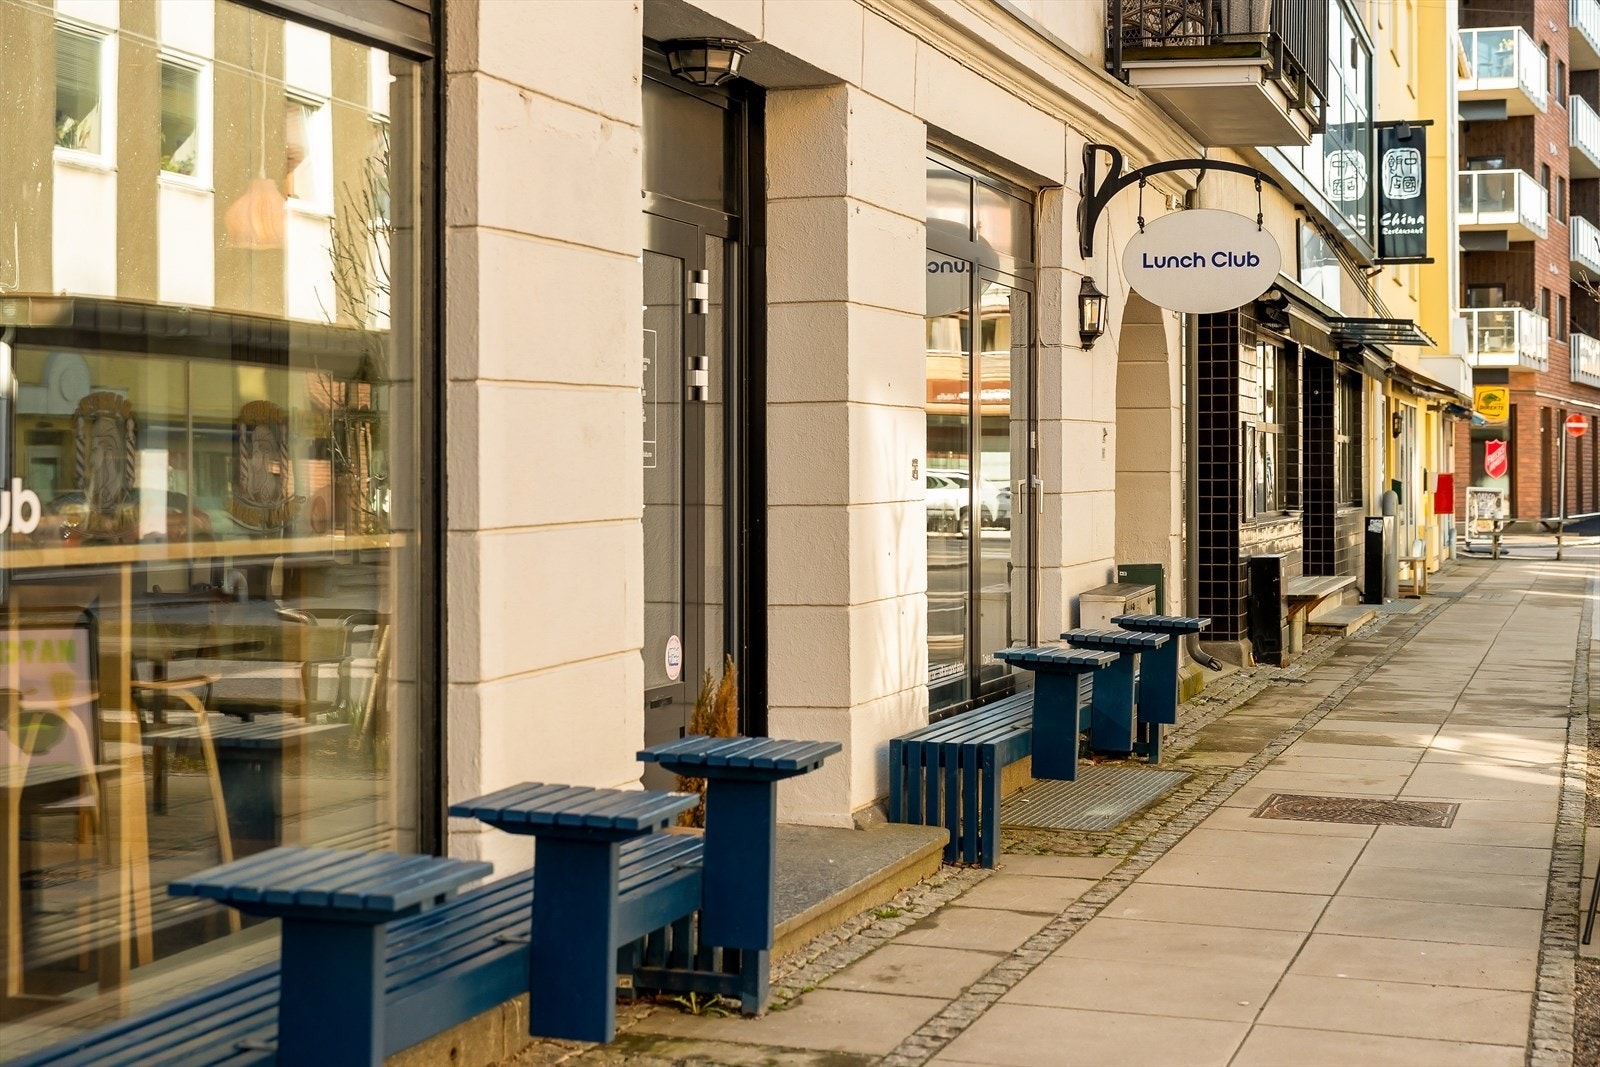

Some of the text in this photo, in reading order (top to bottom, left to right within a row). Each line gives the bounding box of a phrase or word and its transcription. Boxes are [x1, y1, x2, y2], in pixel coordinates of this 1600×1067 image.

[1381, 212, 1425, 227] China
[1142, 251, 1260, 269] Lunch Club
